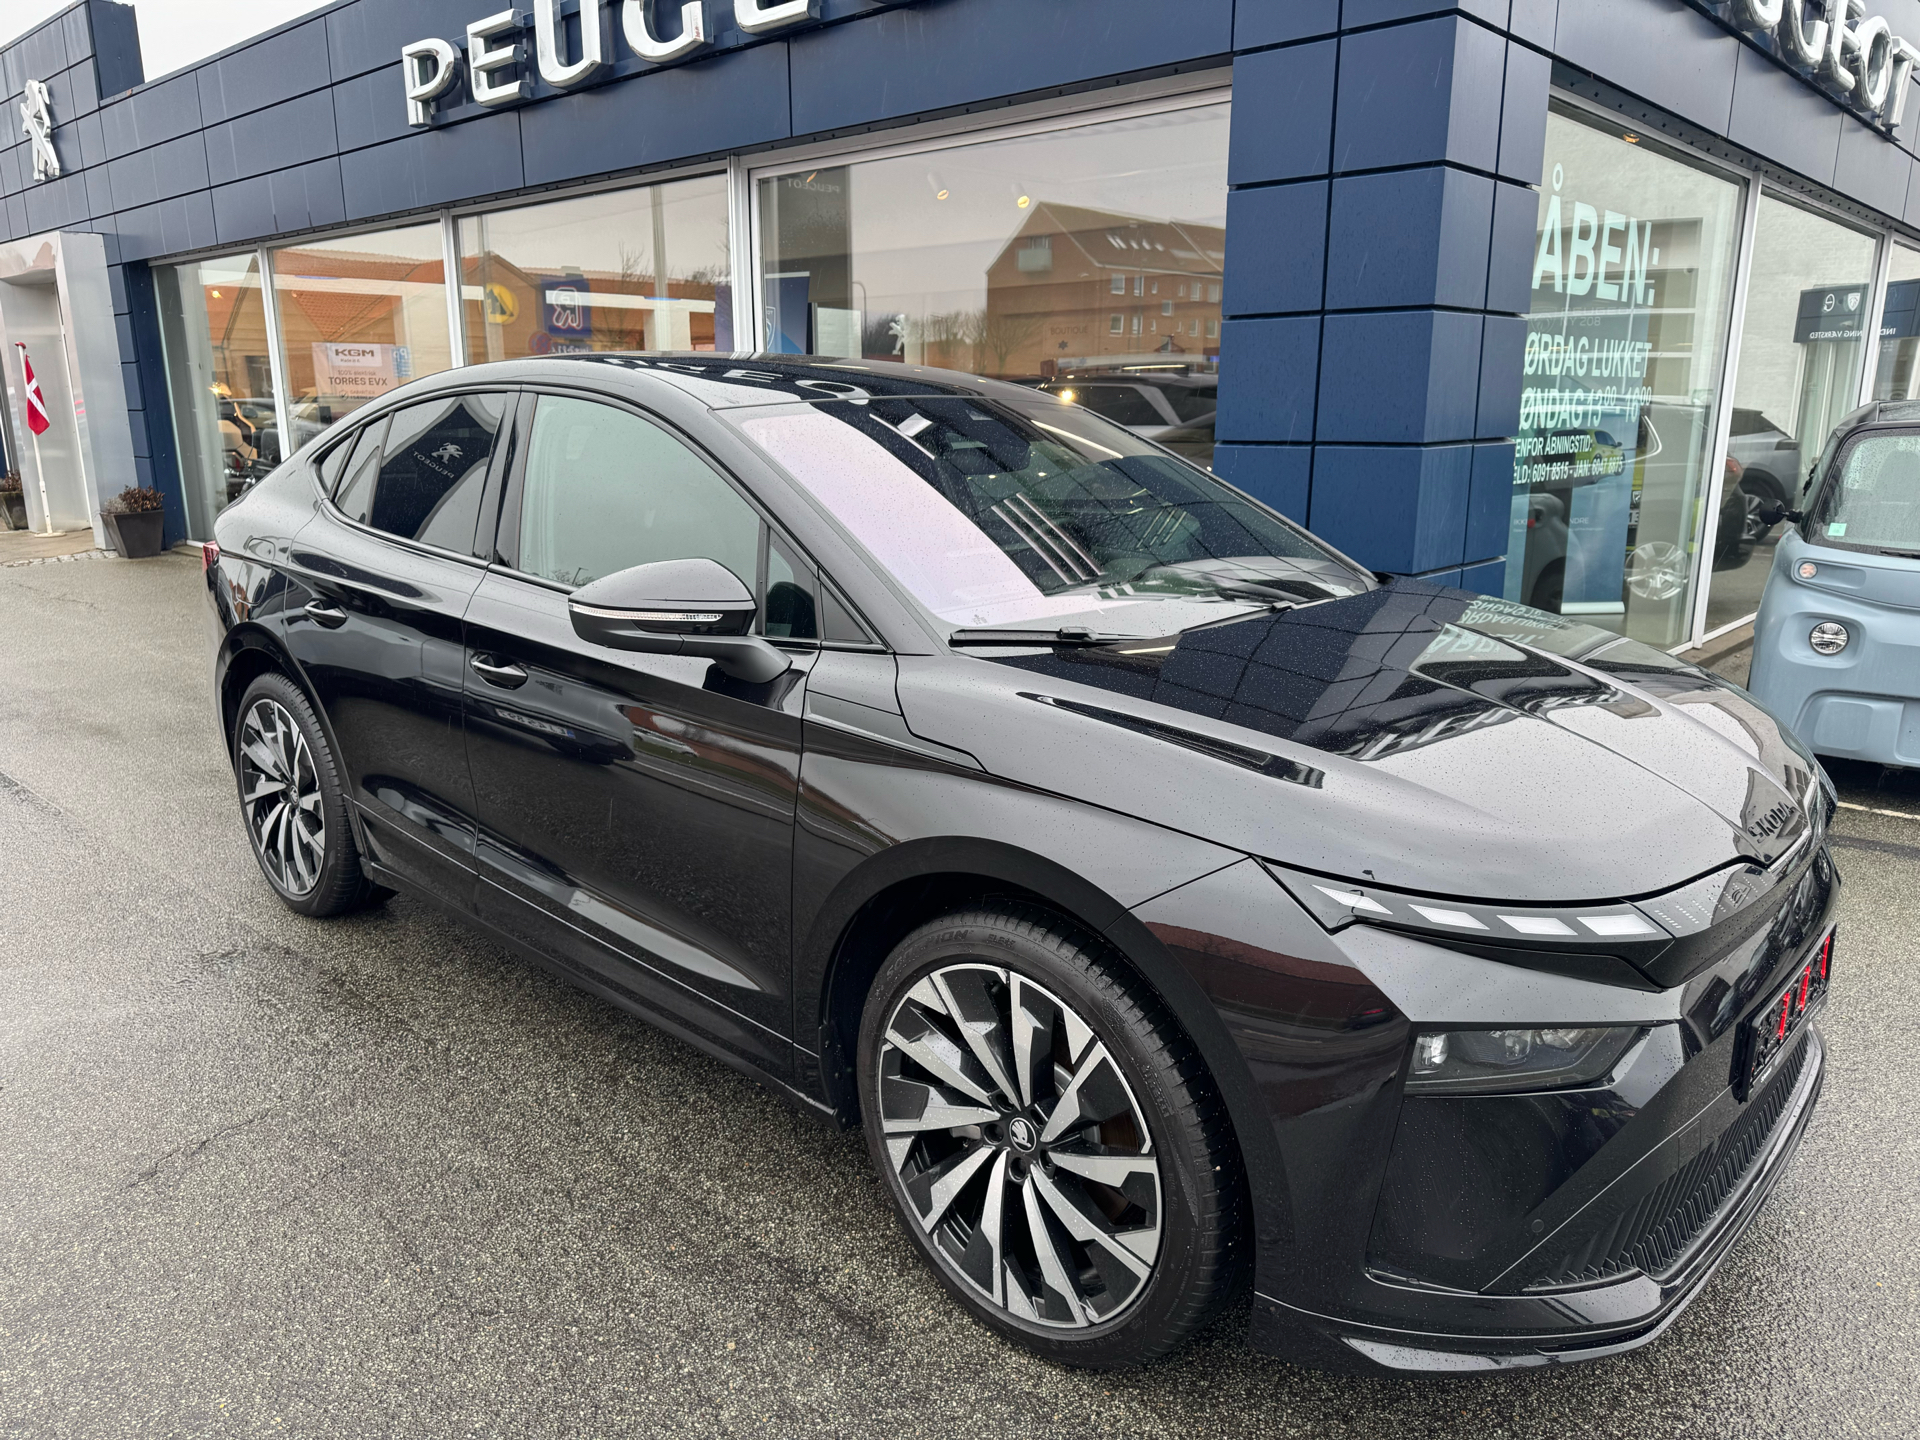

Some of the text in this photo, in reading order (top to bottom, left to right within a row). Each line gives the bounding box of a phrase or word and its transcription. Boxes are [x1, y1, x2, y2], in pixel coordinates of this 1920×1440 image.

[1532, 162, 1660, 306] ÅBEN:
[1580, 316, 1601, 327] 208
[335, 349, 375, 357] KGM
[1592, 338, 1652, 378] LUKKET
[328, 376, 388, 386] TORRES EVX
[1545, 434, 1593, 456] ÅBNINGSTID:
